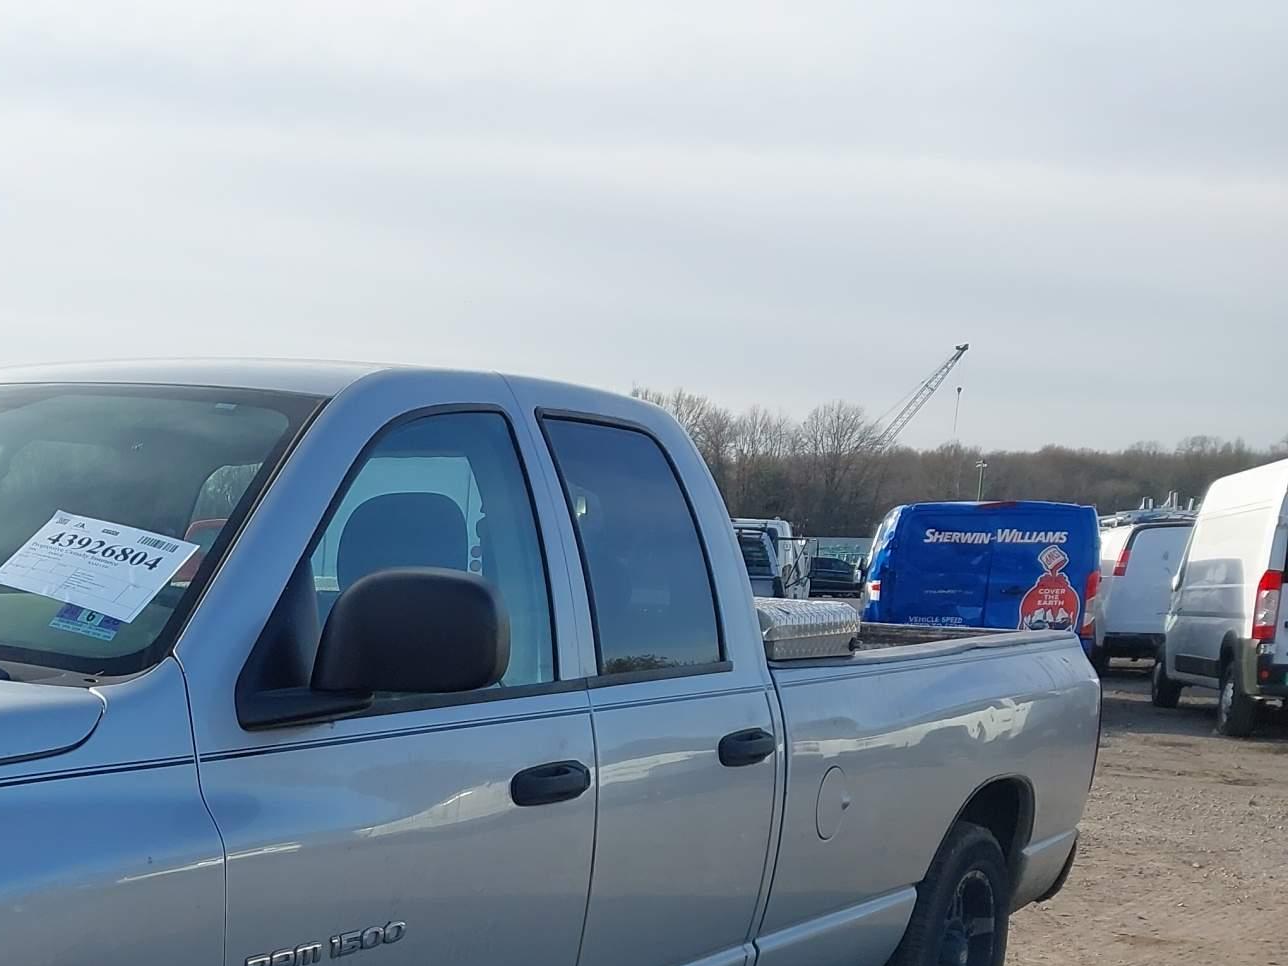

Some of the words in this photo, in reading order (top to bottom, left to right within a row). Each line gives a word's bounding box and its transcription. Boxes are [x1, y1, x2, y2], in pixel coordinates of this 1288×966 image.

[923, 528, 1069, 544] SHERWIN-WILLIAMS
[47, 531, 164, 571] 43926804
[86, 609, 97, 622] 6
[908, 615, 940, 623] VEHICLE
[941, 616, 963, 624] SPEED
[329, 920, 407, 960] 1500
